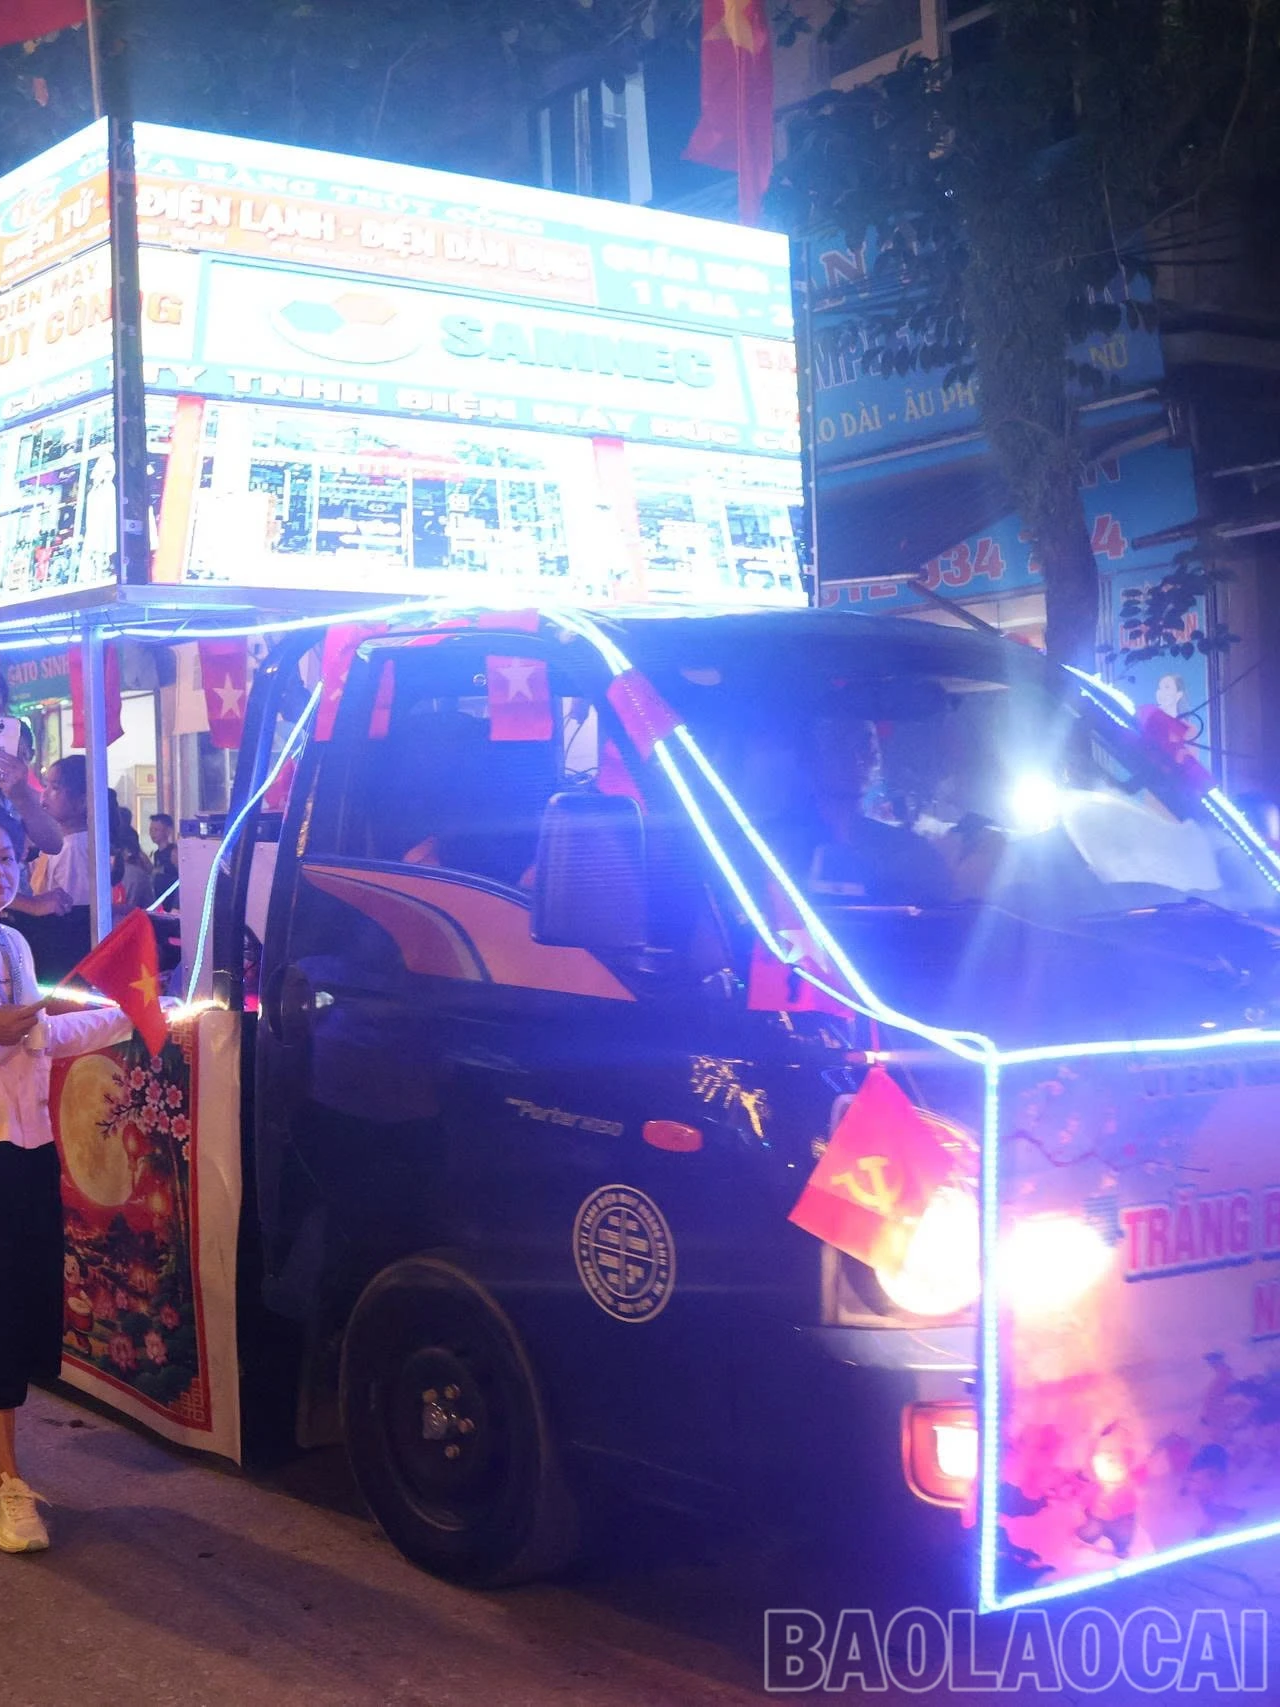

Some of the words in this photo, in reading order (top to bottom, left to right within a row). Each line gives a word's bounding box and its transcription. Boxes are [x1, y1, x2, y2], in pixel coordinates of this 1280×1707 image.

[440, 315, 715, 388] SAMNEC
[227, 368, 379, 406] TNHH
[840, 401, 882, 439] DÀI
[1120, 1186, 1253, 1281] TRĂNG
